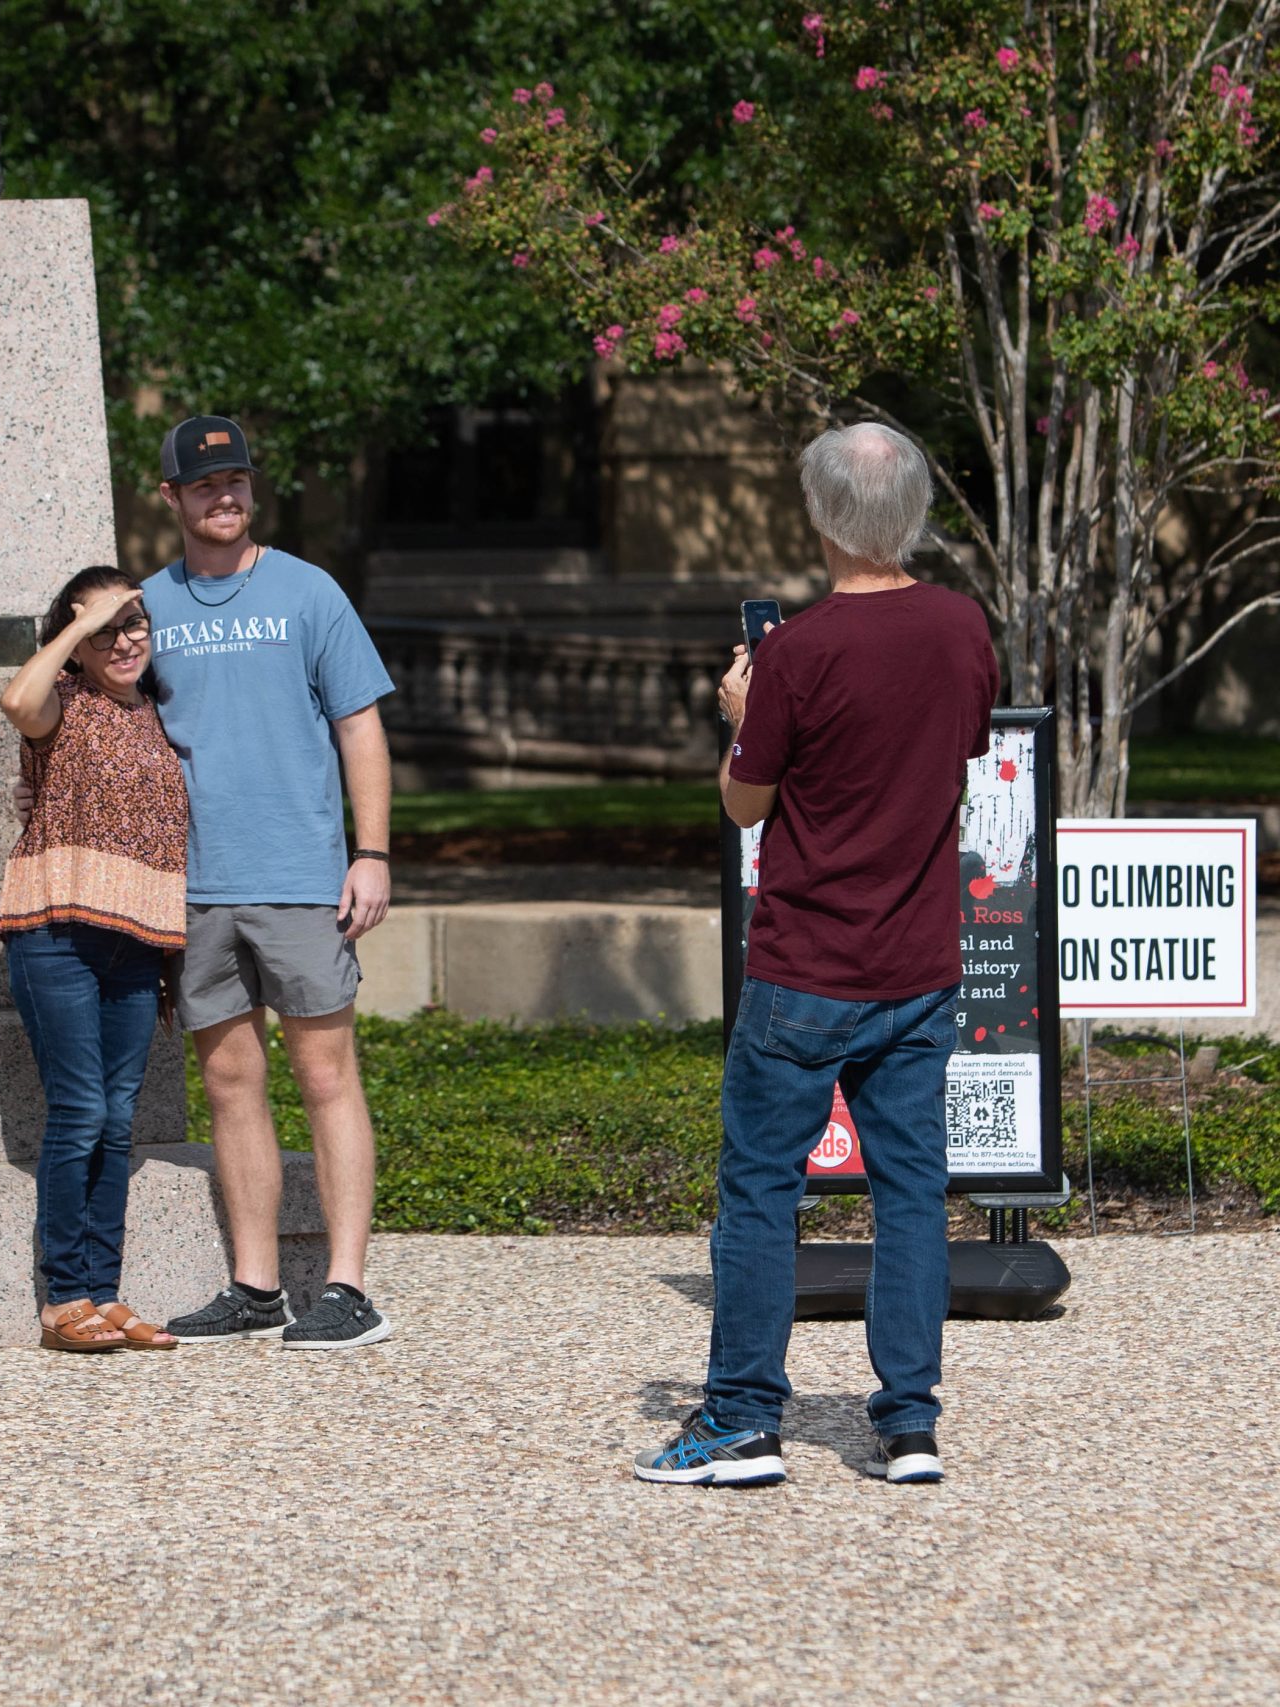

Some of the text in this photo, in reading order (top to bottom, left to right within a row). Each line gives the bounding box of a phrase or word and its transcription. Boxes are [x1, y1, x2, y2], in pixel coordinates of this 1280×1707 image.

[152, 616, 289, 653] TEXAS A&M
[1062, 864, 1235, 908] O CLIMBING
[973, 906, 1024, 924] Ross
[979, 934, 1014, 951] and
[1060, 937, 1216, 981] ON STATUE
[971, 983, 1006, 999] and
[946, 1069, 981, 1079] ampaign
